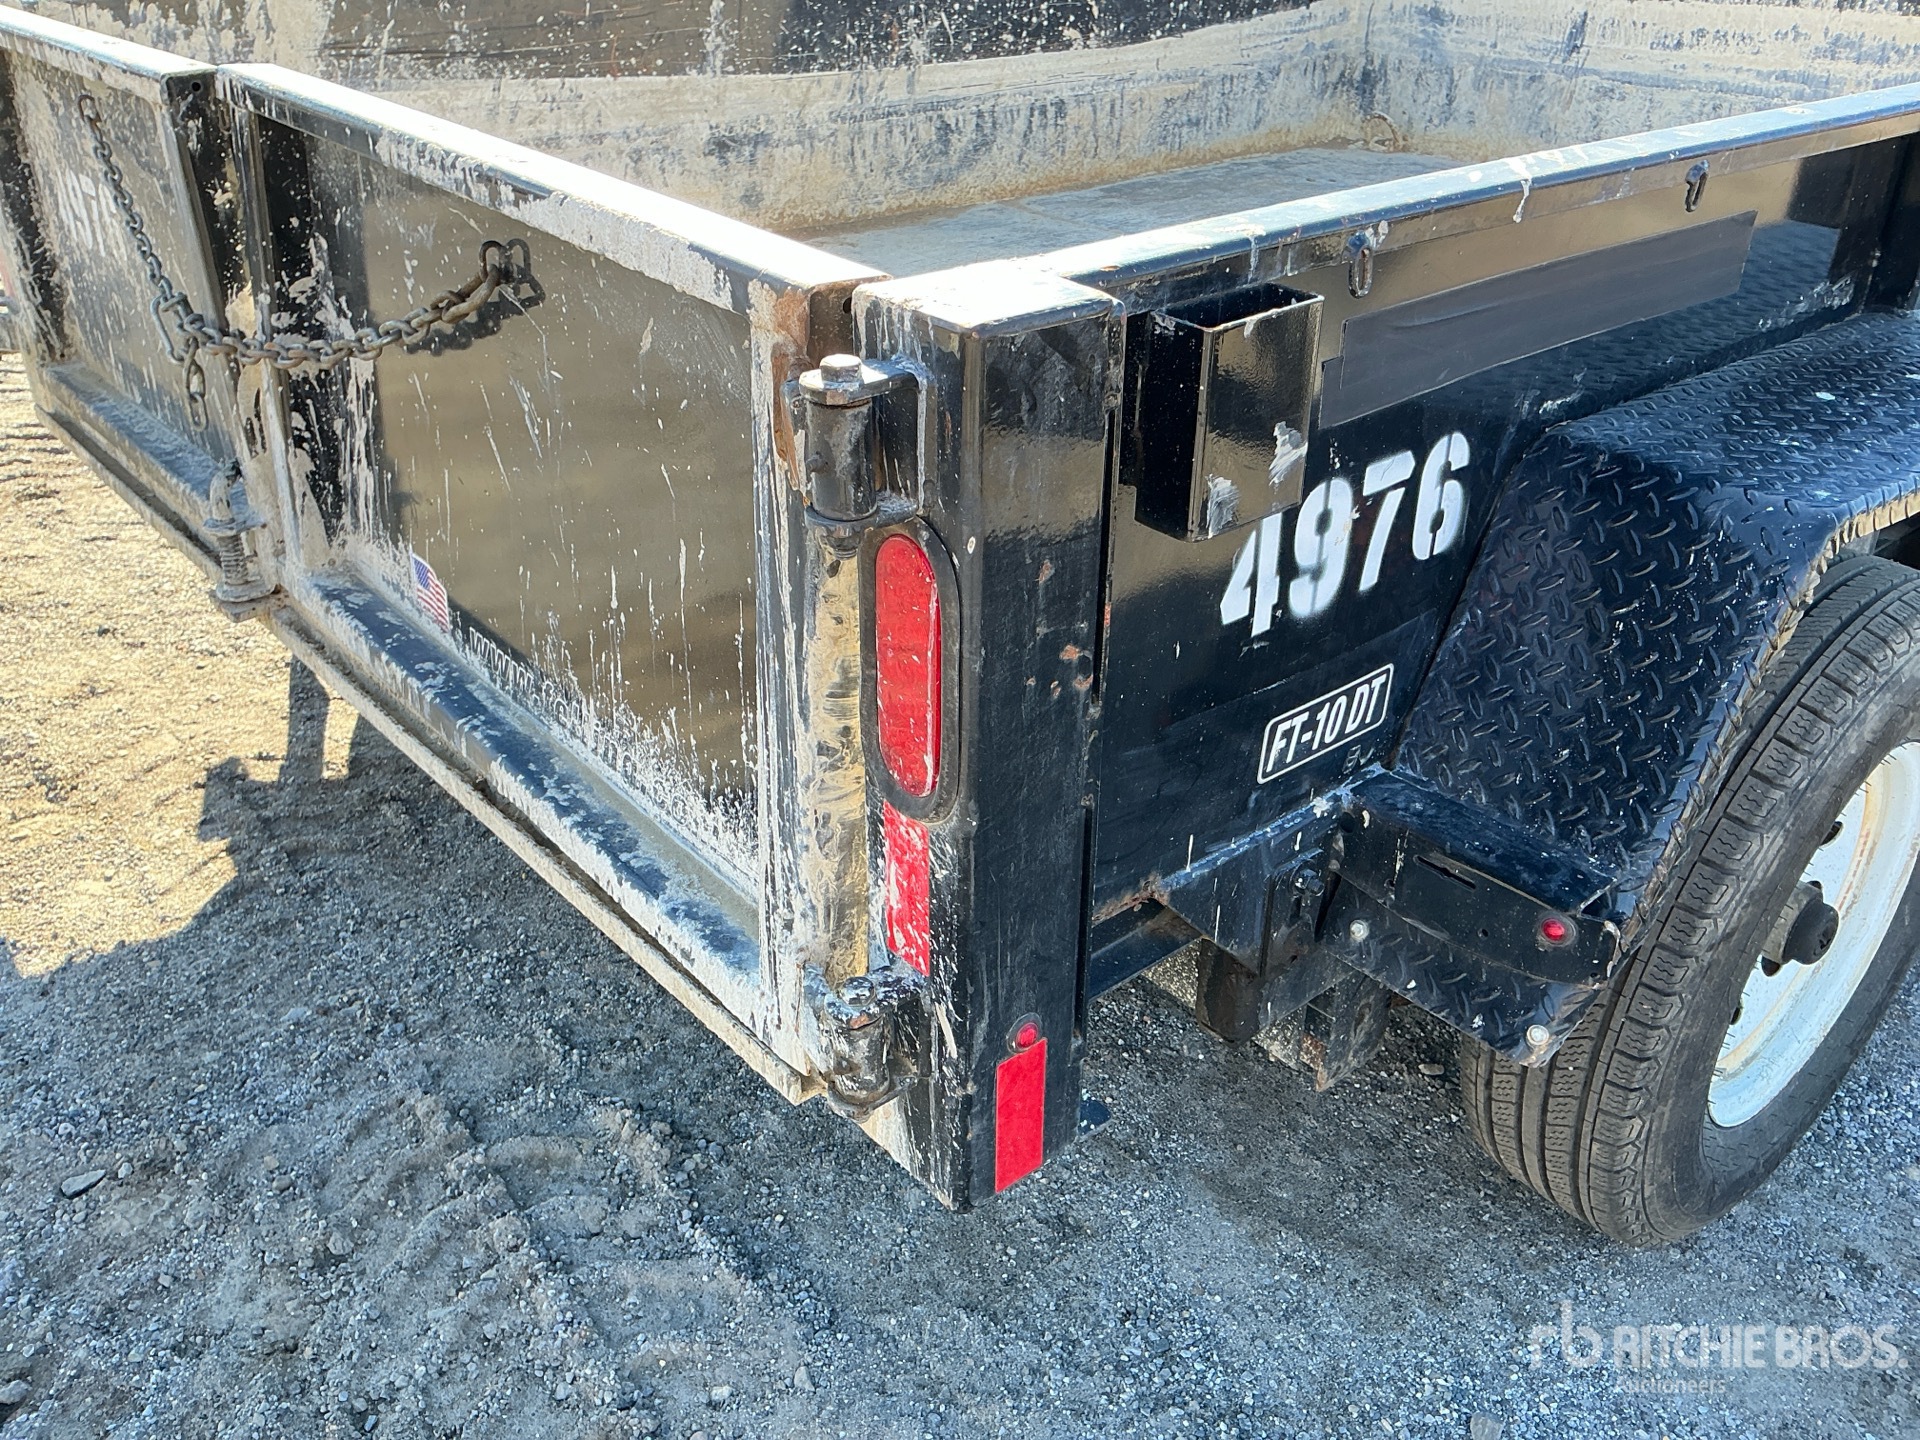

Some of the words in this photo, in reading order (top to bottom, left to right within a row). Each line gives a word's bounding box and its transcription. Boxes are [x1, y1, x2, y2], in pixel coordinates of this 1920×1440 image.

[1220, 432, 1470, 637] 4976
[1266, 695, 1347, 772] FT-10
[1346, 674, 1387, 733] DT
